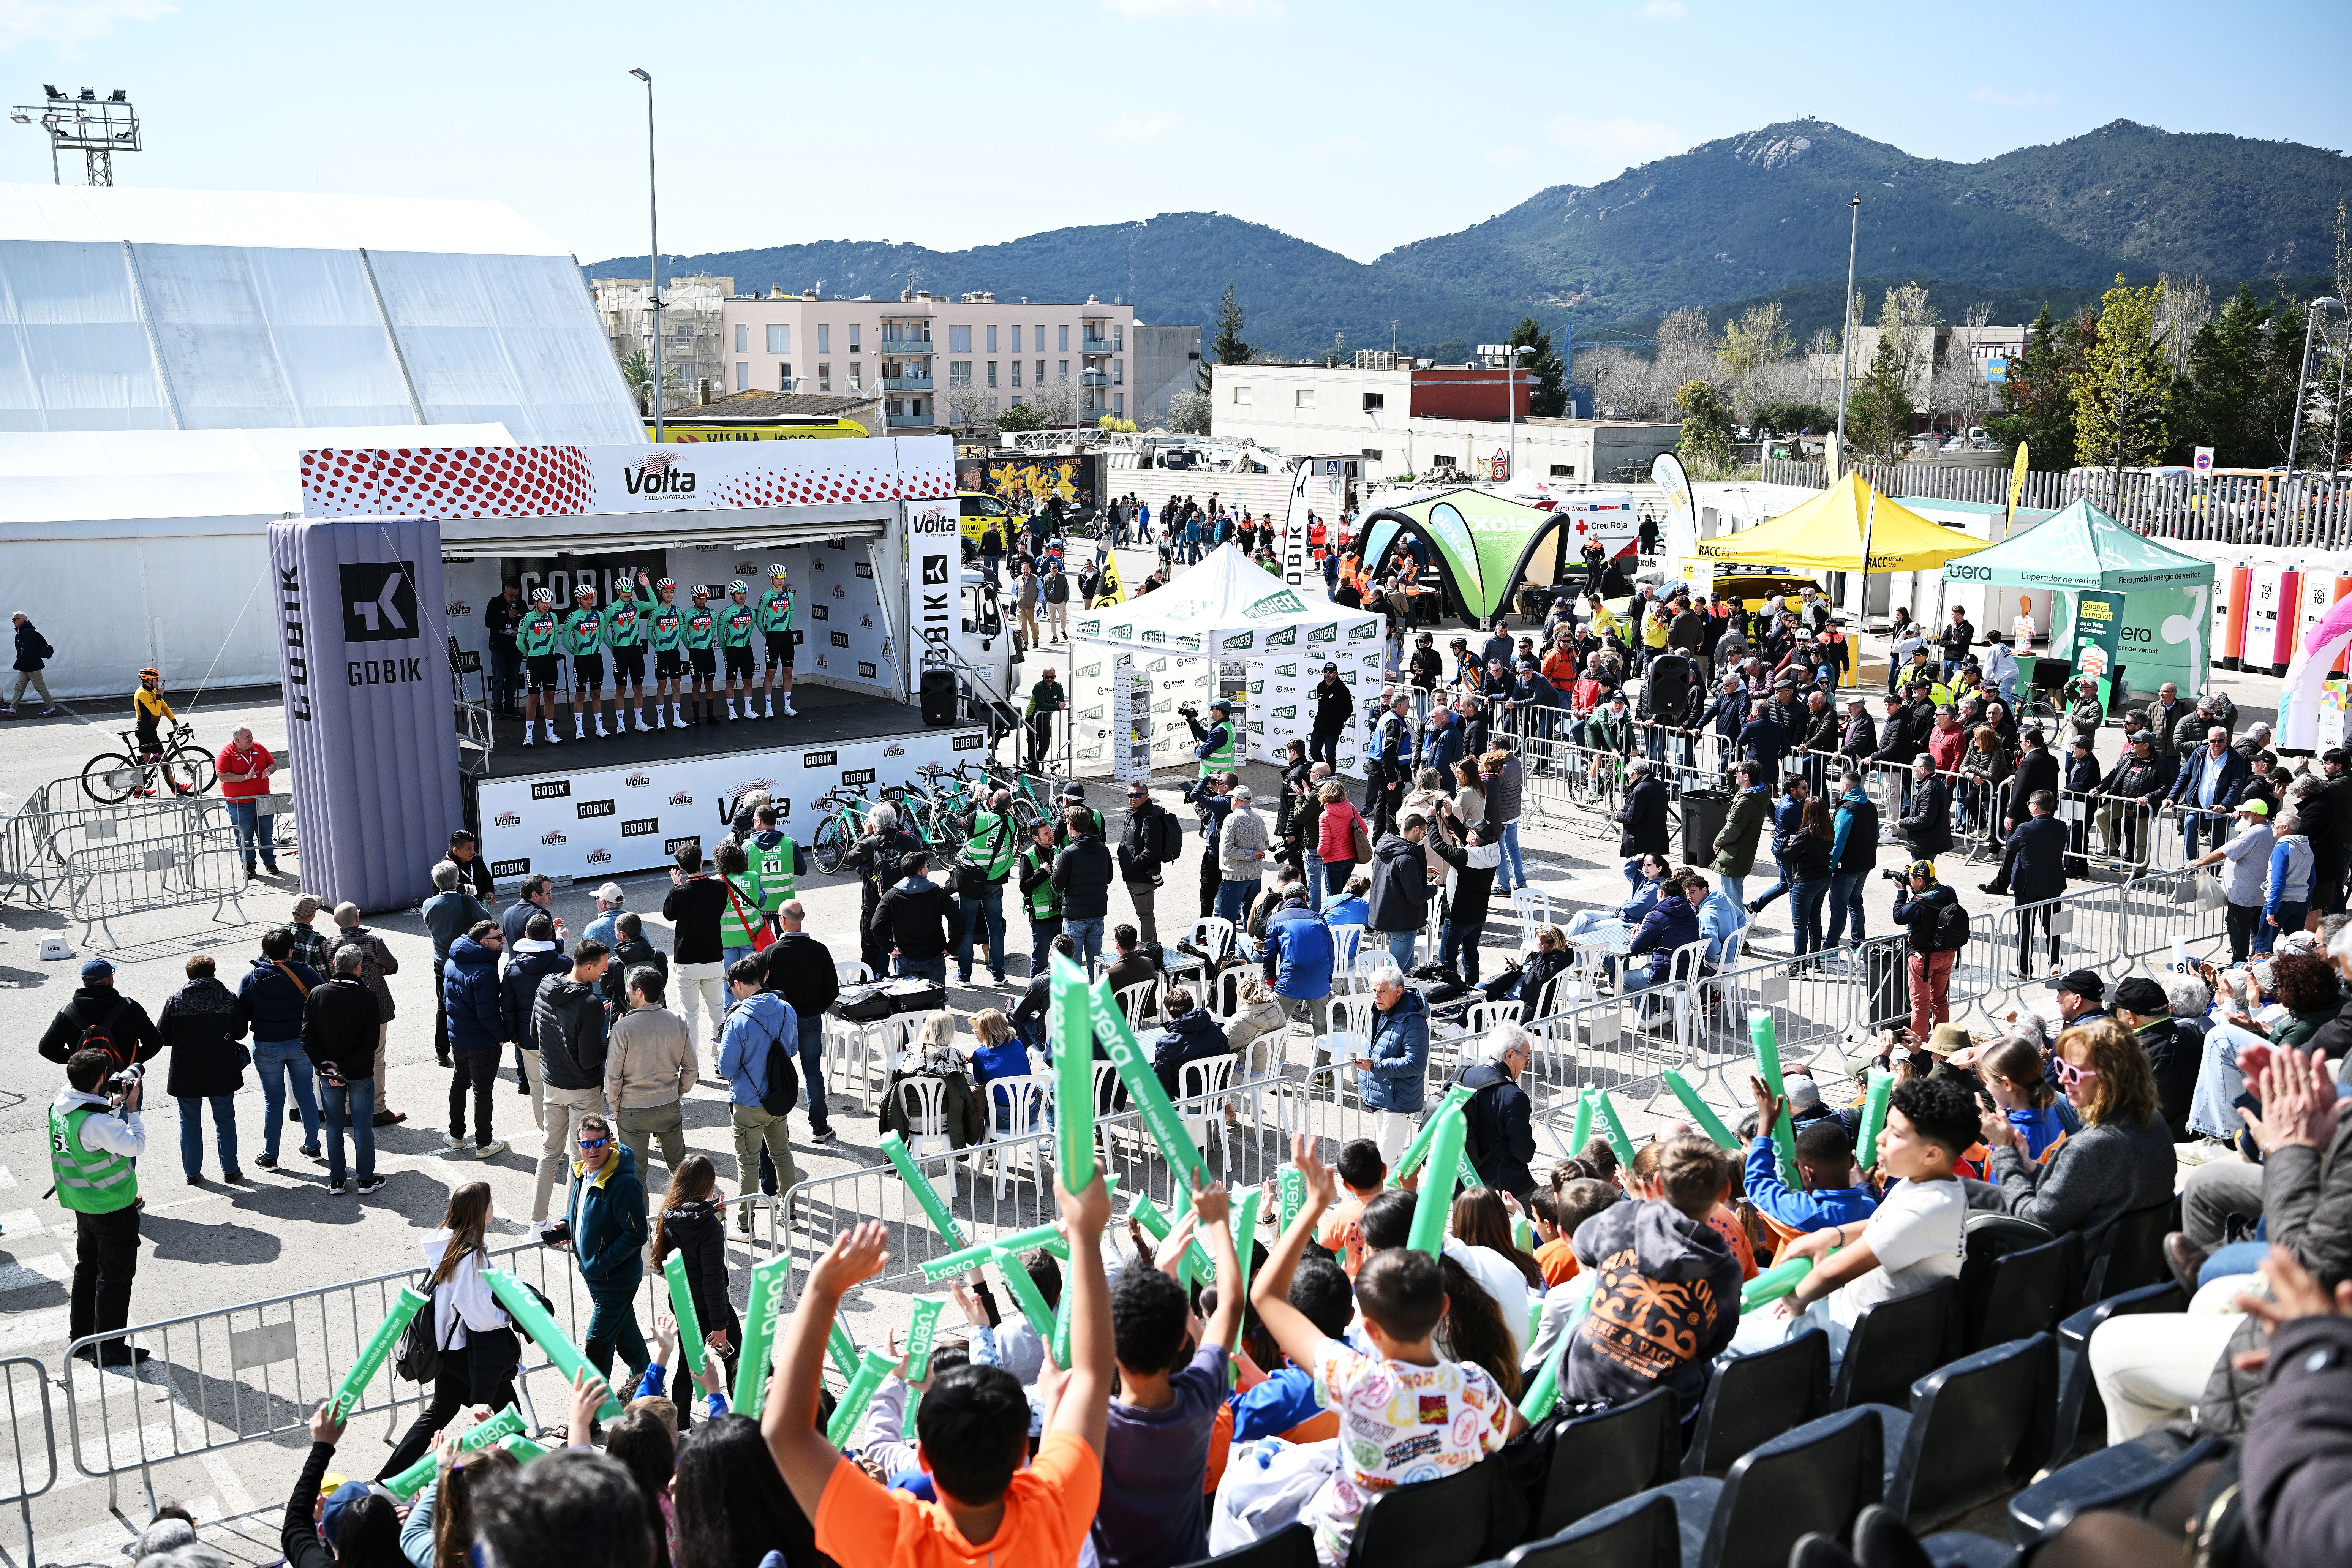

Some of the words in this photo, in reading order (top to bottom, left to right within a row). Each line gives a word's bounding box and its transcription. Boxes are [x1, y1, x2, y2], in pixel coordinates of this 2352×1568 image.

[624, 465, 696, 494] Volta
[913, 514, 956, 533] Volta
[1611, 522, 1627, 531] Roja
[1699, 545, 1720, 557] RACC
[813, 561, 824, 571] Volta
[1868, 557, 1887, 568] RACC
[735, 565, 757, 575] Volta
[857, 565, 871, 576] GOBIK
[2022, 572, 2061, 582] L'operador
[2135, 575, 2150, 583] mòbil
[2154, 574, 2174, 582] energia
[521, 567, 638, 610] GOBIK
[832, 587, 844, 597] Volta
[445, 604, 471, 615] Volta
[1244, 595, 1302, 619] FINISHER
[2083, 602, 2108, 611] Guanya
[813, 607, 826, 618] GOBIK
[860, 617, 872, 628] Volta
[923, 593, 948, 667] OBIK
[1109, 626, 1131, 639] FINISHER
[1307, 626, 1336, 642] FINISHER
[1349, 623, 1376, 639] FINISHER
[2083, 627, 2107, 635] Catalunya
[2121, 627, 2151, 643] era
[832, 634, 846, 645] GOBIK
[1142, 631, 1165, 643] FINISHER
[1223, 634, 1252, 650] FINISHER
[1266, 629, 1294, 645] FINISHER
[280, 565, 312, 722] GOBIK
[816, 658, 827, 667] Volta
[1146, 661, 1165, 672] FINISHER
[1363, 656, 1378, 667] FINISHER
[348, 656, 422, 686] GOBIK
[860, 664, 874, 676] GOBIK
[1076, 665, 1099, 676] FINISHER
[1275, 665, 1296, 675] FINISHER
[1078, 708, 1102, 719] FINISHER
[1271, 708, 1295, 718] FINISHER
[955, 737, 978, 748] GOBIK
[883, 747, 904, 757] Volta
[1077, 748, 1100, 758] FINISHER
[806, 754, 832, 765] GOBIK
[625, 776, 650, 787] Volta
[845, 772, 871, 783] GOBIK
[534, 784, 565, 797] GOBIK
[669, 795, 692, 805] Volta
[580, 803, 609, 816] GOBIK
[495, 815, 521, 827] Volta
[624, 821, 653, 834] GOBIK
[541, 834, 567, 845] Volta
[586, 850, 611, 863] Volta
[494, 862, 525, 875] GOBIK
[764, 861, 779, 873] 11
[1129, 1077, 1149, 1106] Fibra
[1148, 1111, 1170, 1142] mòbil
[1164, 1141, 1176, 1157] de
[352, 1369, 369, 1385] Fibra
[365, 1347, 382, 1366] mòbil
[384, 1317, 403, 1339] veritat
[849, 1386, 871, 1418] veritat
